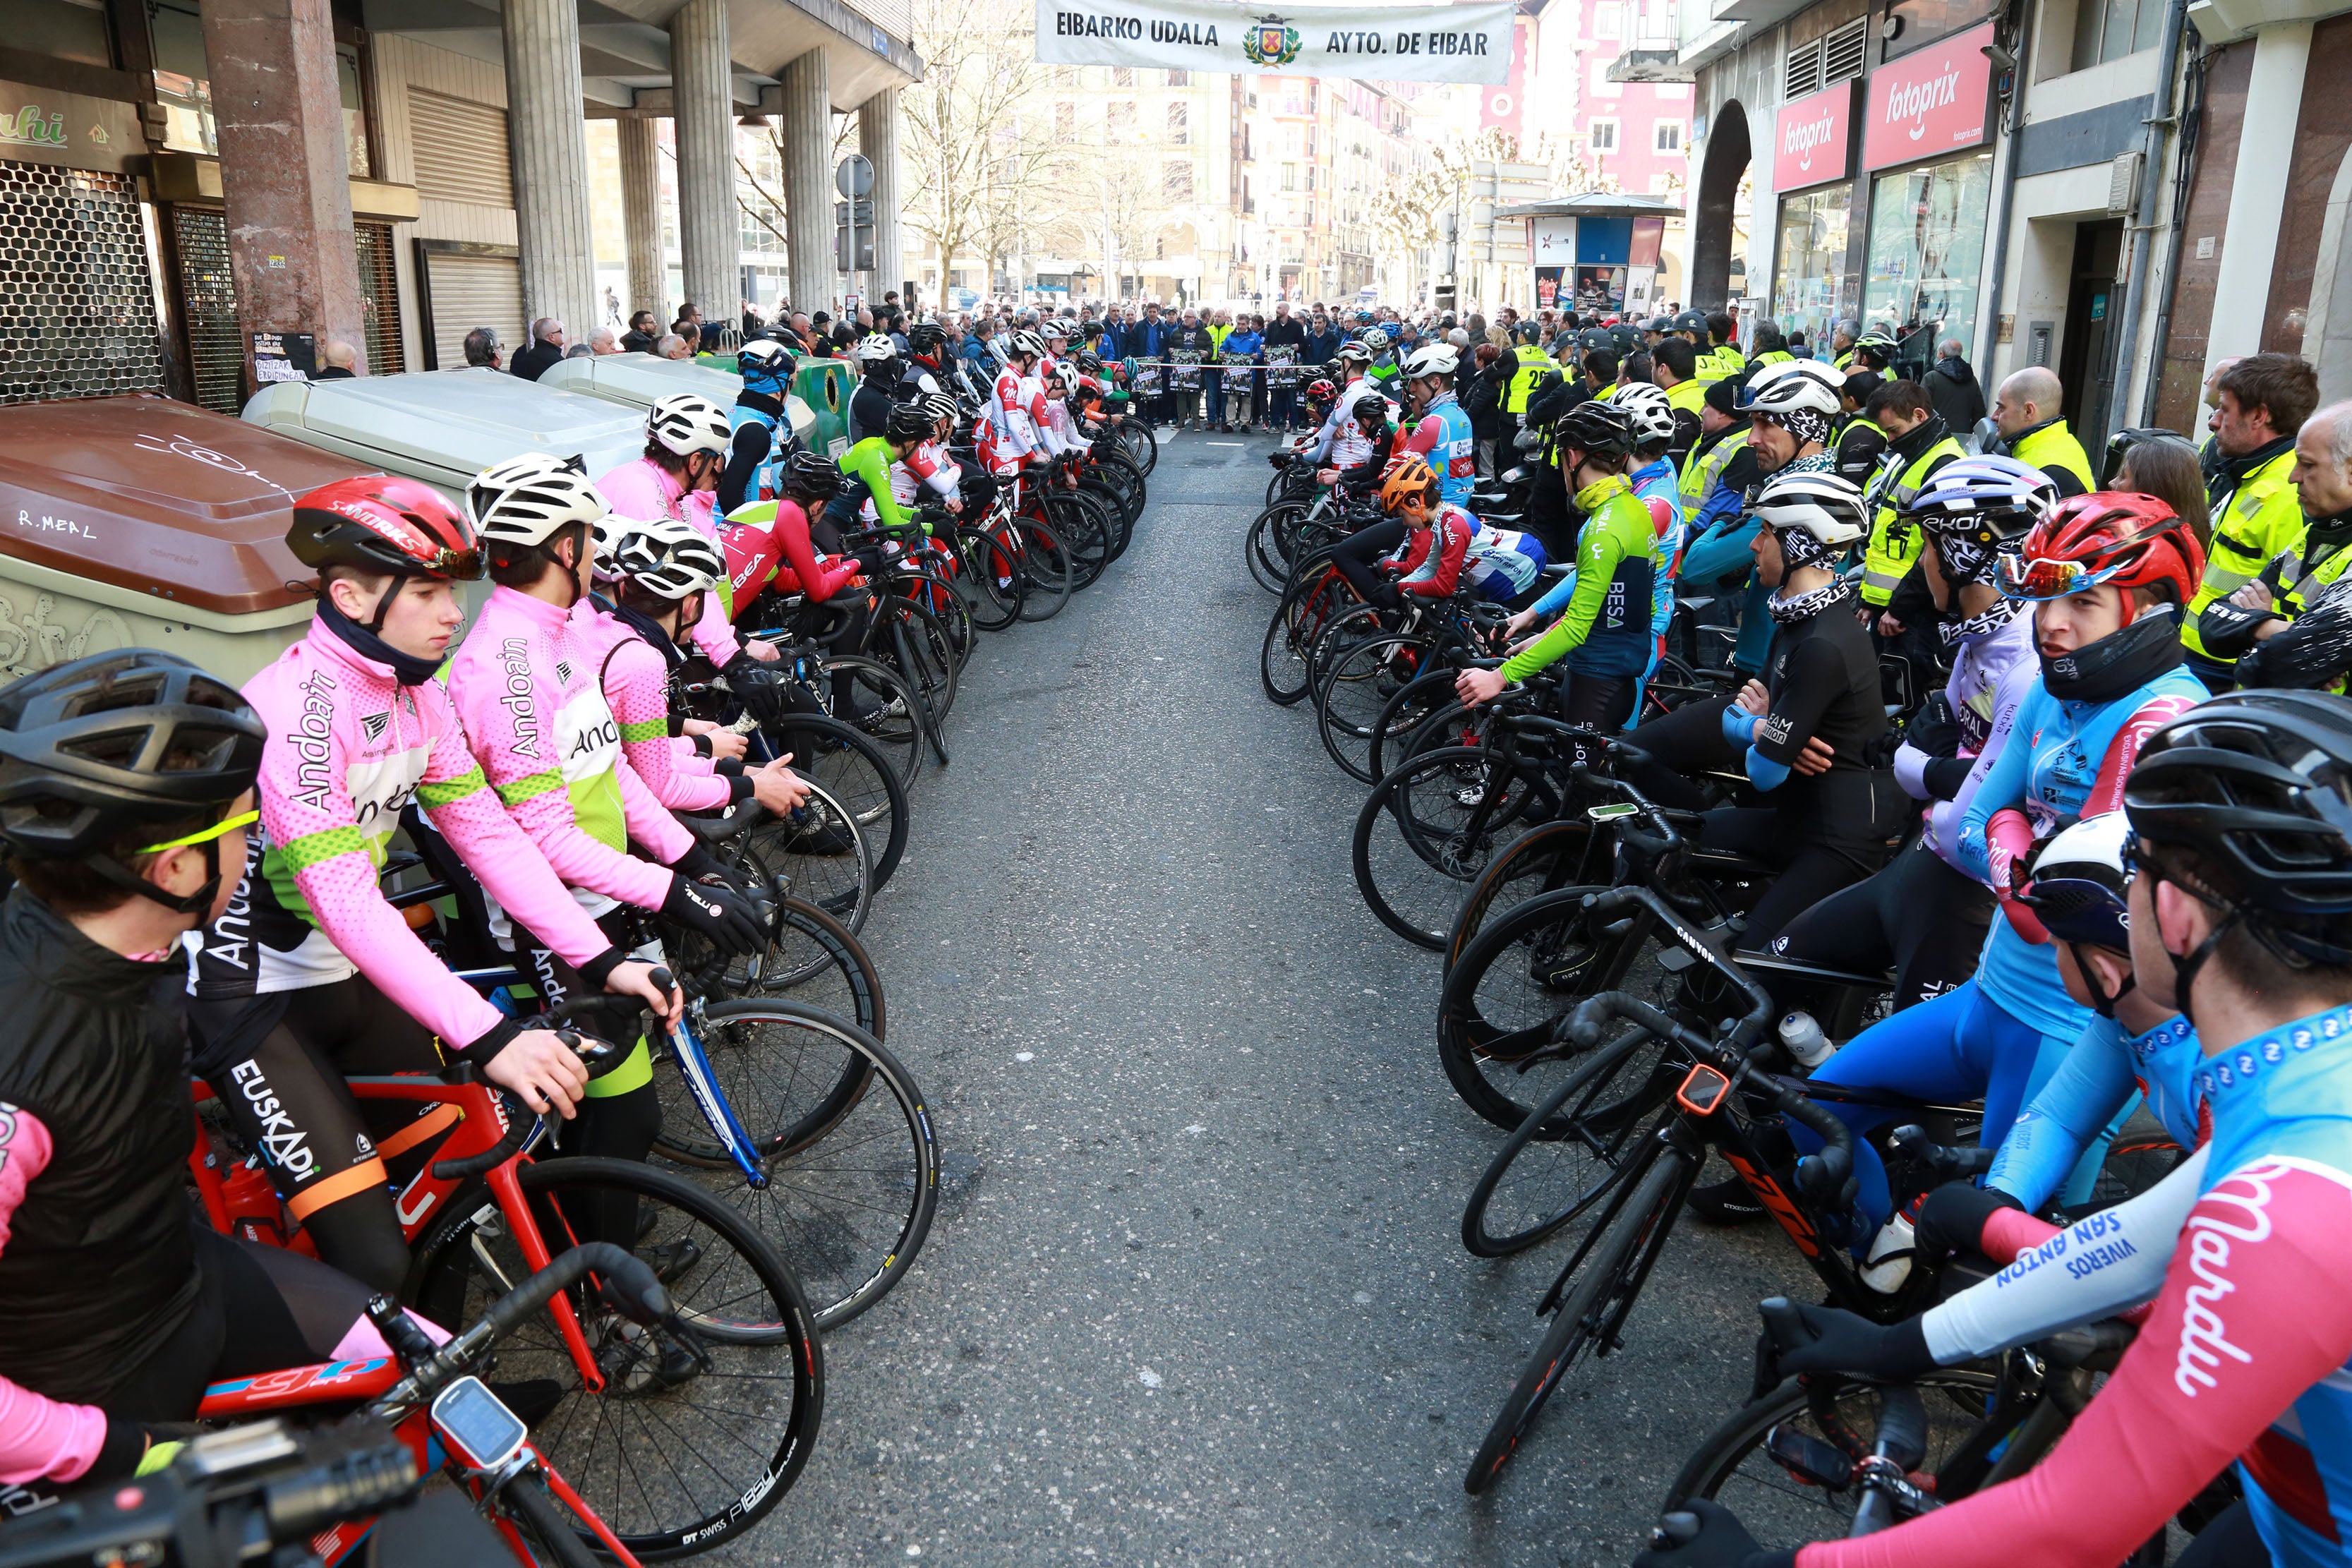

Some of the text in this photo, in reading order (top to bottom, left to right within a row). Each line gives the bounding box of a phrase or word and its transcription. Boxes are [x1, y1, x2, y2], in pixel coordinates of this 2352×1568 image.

[1057, 12, 1219, 47] EIBARKO UDALA
[1327, 32, 1488, 56] AYTO. DE EIBAR
[1886, 61, 1960, 124] fotoprix
[1784, 107, 1834, 157] fotoprix
[1953, 126, 1982, 141] fotoprix.com
[257, 361, 288, 370] BIZITZAK
[258, 370, 306, 380] ERDIGUNEAN
[1818, 385, 1831, 398] ABUS
[327, 500, 423, 552] S-WORKS
[1491, 554, 1522, 575] SAN ANTON
[1607, 581, 1624, 629] BESA
[495, 637, 539, 760] Andoain
[1996, 704, 2018, 734] kutxa
[287, 670, 337, 814] Andoain
[2109, 734, 2132, 811] EXCLUSIVAS GOURMET
[1677, 926, 1715, 963] CANYON
[682, 1067, 734, 1153] ORBEA
[920, 1112, 931, 1140] MICHELIN
[1723, 1202, 1763, 1213] ETXEONDO
[1996, 1212, 2122, 1289] SAN ANTON
[2065, 1238, 2137, 1280] VIVEROS
[2174, 1164, 2293, 1398] Mardu
[682, 1532, 699, 1545] DT
[699, 1519, 728, 1540] SWISS
